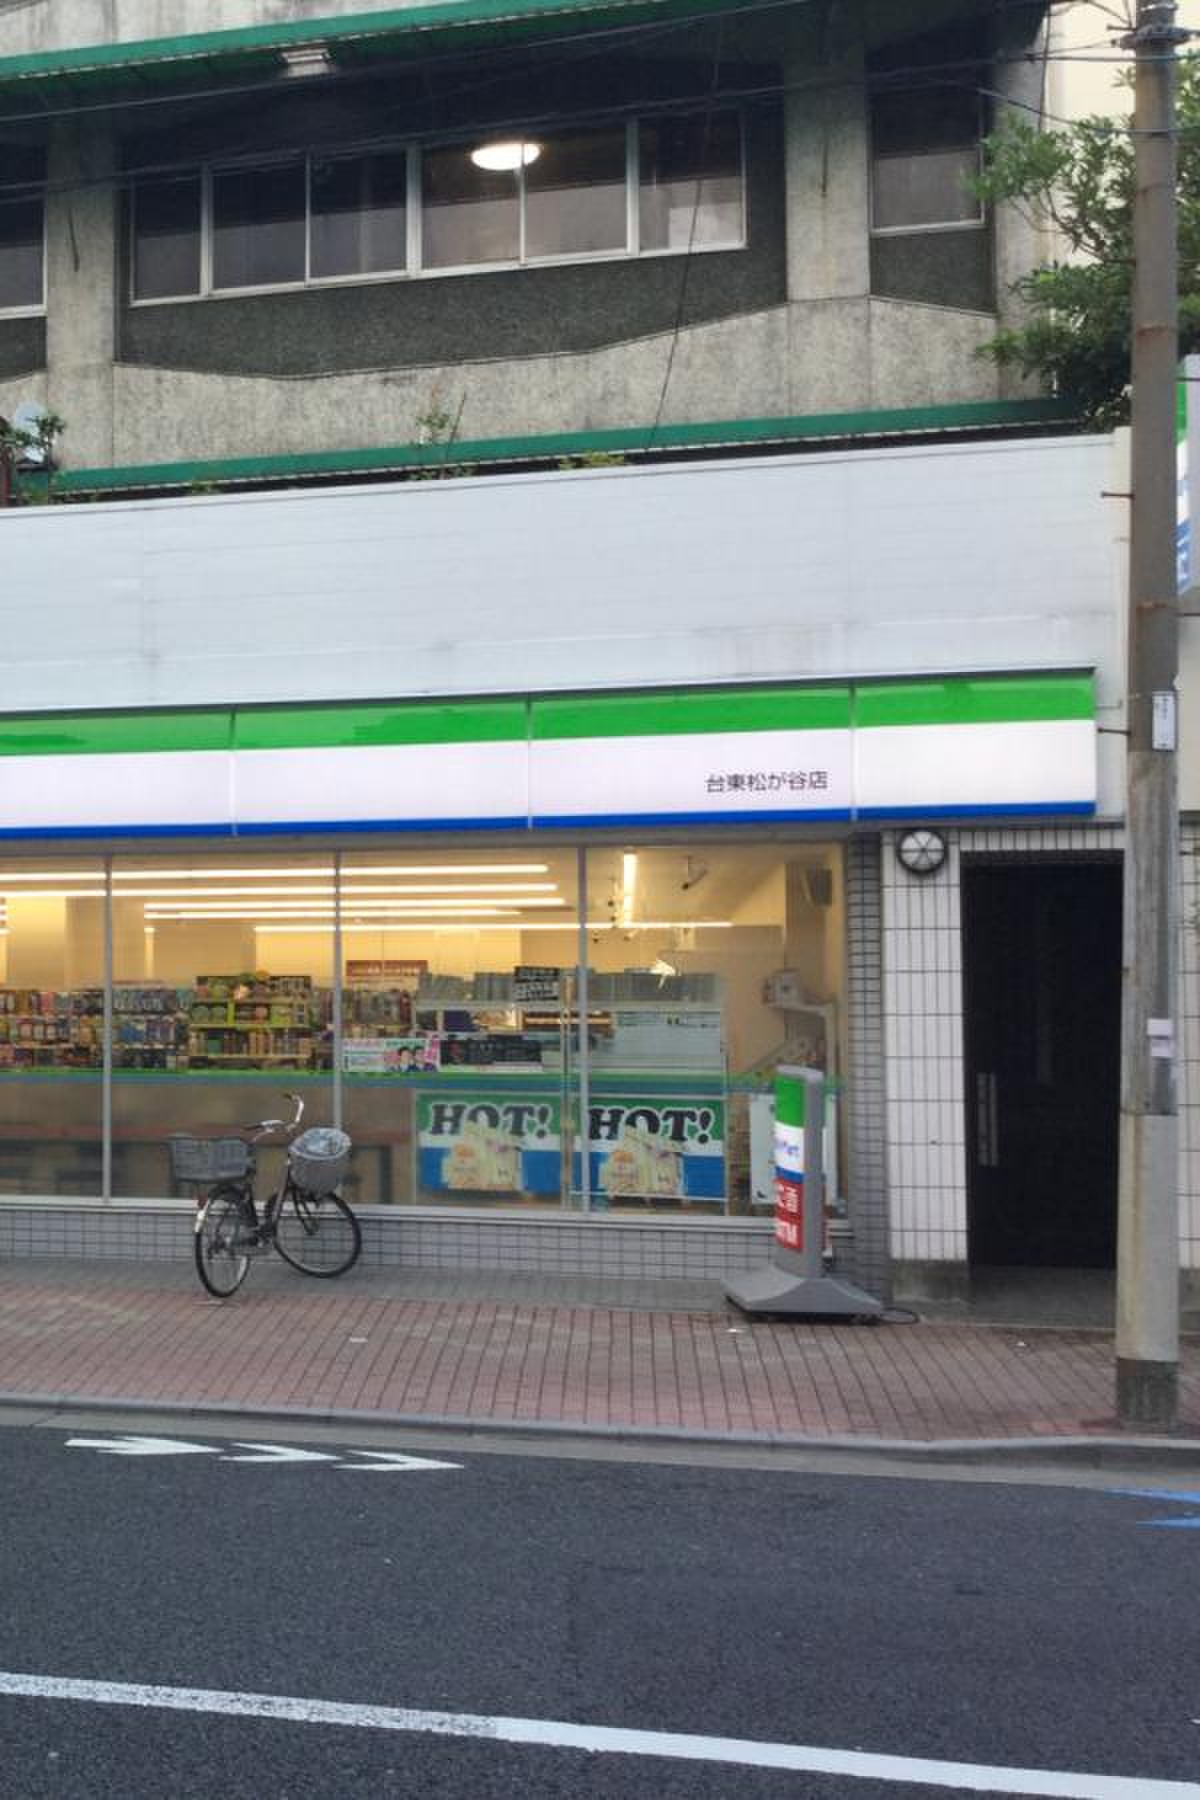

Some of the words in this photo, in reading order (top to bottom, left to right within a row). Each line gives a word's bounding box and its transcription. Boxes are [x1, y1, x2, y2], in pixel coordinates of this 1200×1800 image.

[705, 770, 828, 793] 台東松が谷店
[431, 1102, 549, 1138] HOT!
[589, 1107, 712, 1144] HOT!
